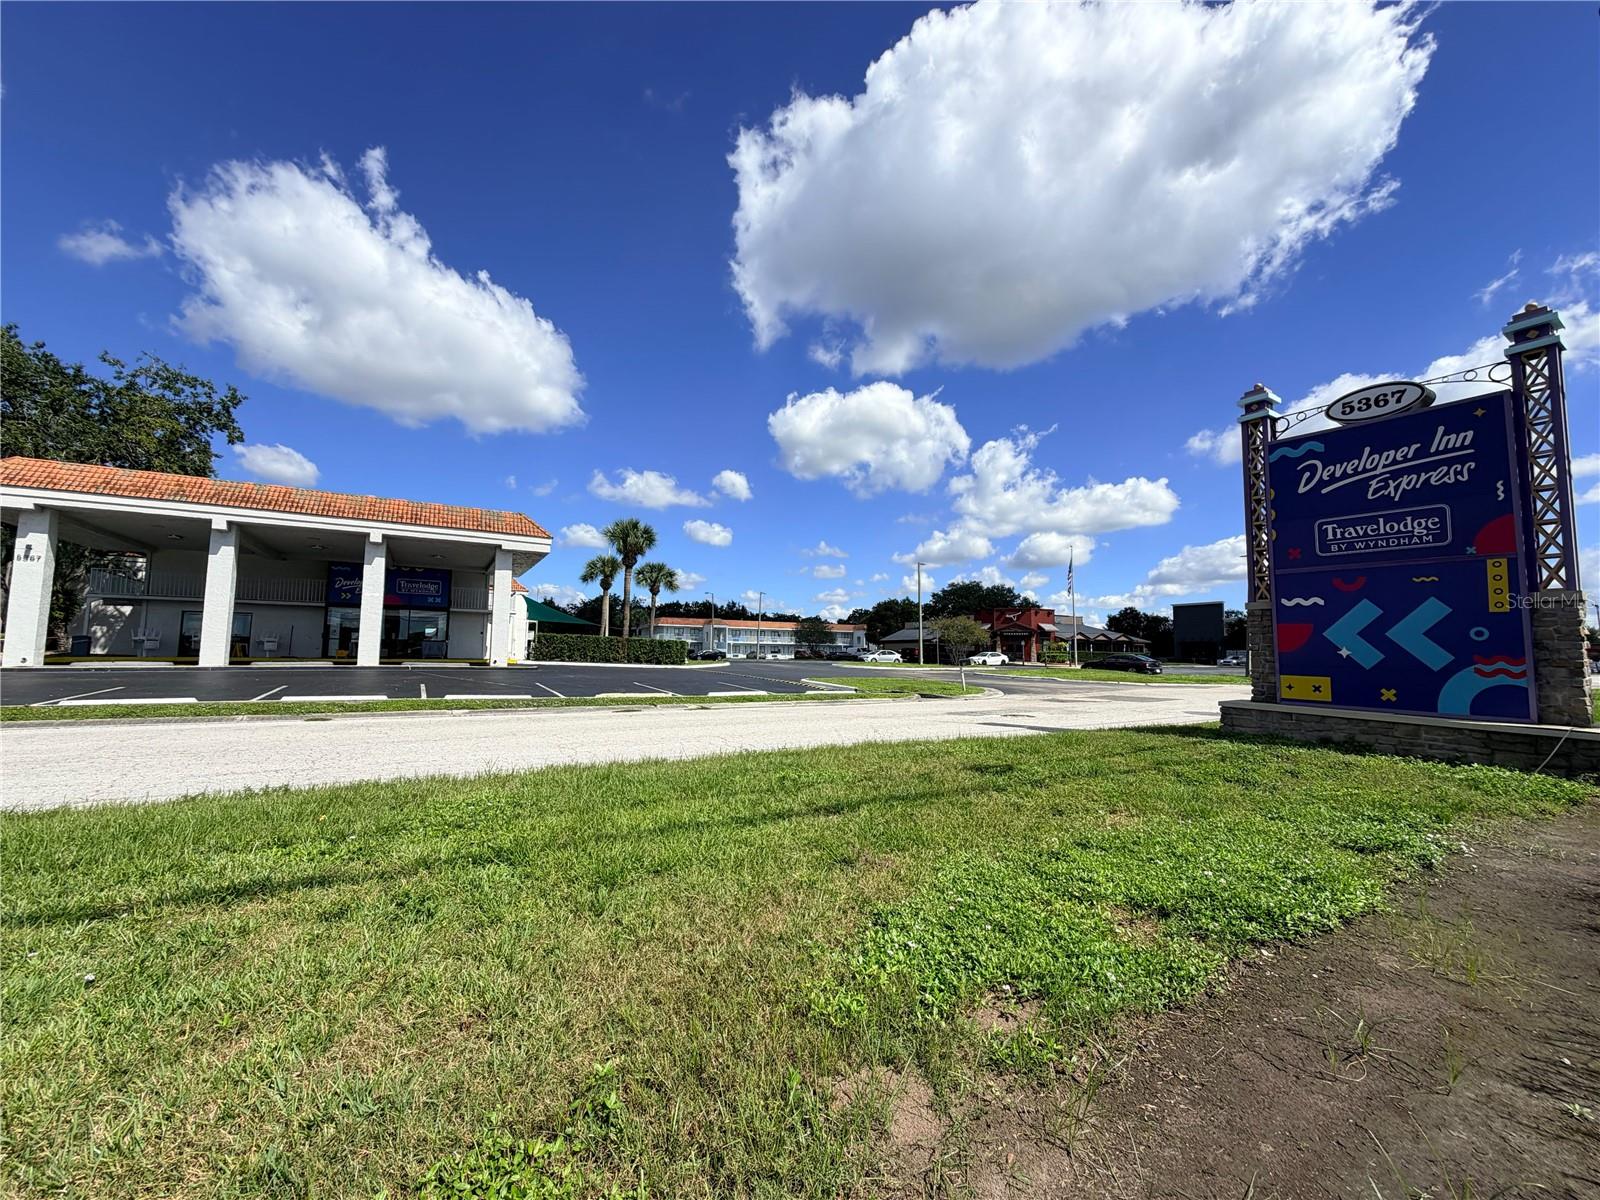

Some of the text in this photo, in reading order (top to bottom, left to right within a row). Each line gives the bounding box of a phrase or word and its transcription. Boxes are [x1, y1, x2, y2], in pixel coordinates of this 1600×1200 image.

[1341, 388, 1407, 415] 5367
[1297, 425, 1474, 493] Developer Inn
[1367, 462, 1476, 501] Express
[1322, 516, 1440, 540] Travelodge
[1331, 535, 1433, 552] BY WYNDHAM
[334, 577, 363, 589] Develo
[399, 580, 439, 591] Travelodge
